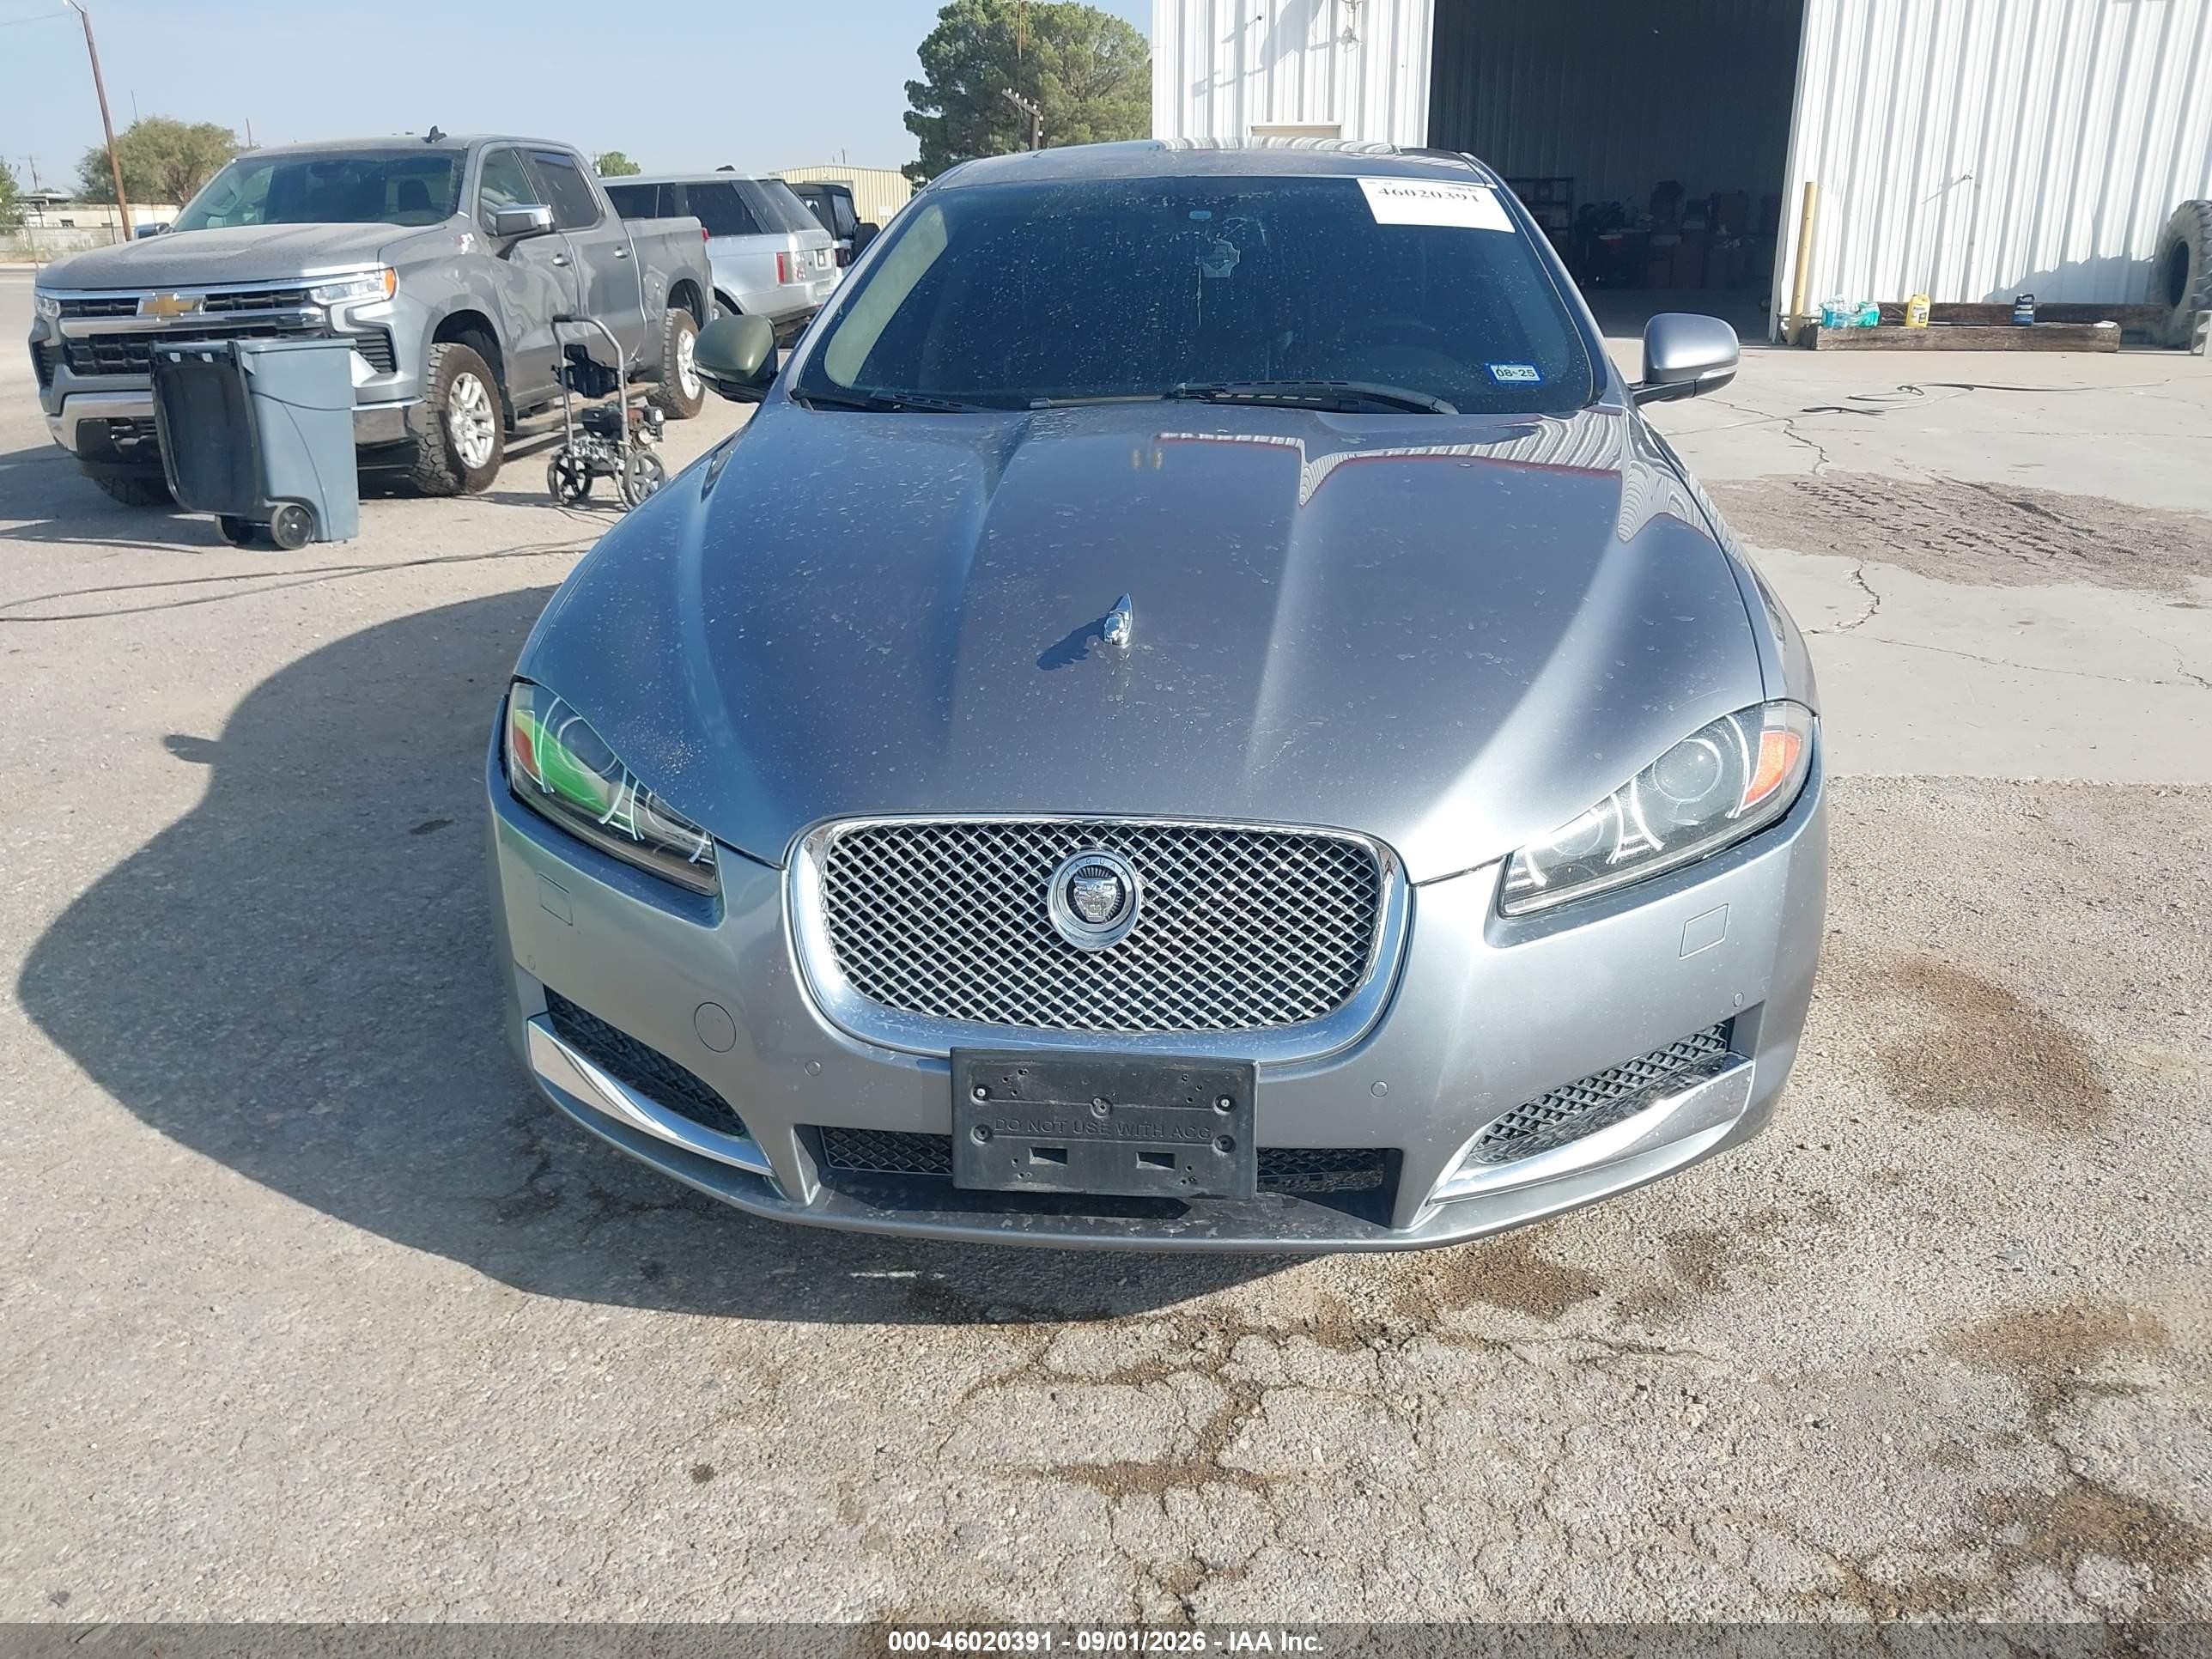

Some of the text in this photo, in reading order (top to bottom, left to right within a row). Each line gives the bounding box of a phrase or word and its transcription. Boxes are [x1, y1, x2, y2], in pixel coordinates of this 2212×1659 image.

[1378, 187, 1479, 203] 46020391
[1066, 859, 1127, 878] JAGUAR
[994, 1118, 1021, 1132] DO
[1027, 1119, 1066, 1133] NOT
[1073, 1120, 1111, 1135] USE
[1115, 1122, 1164, 1138] WITH
